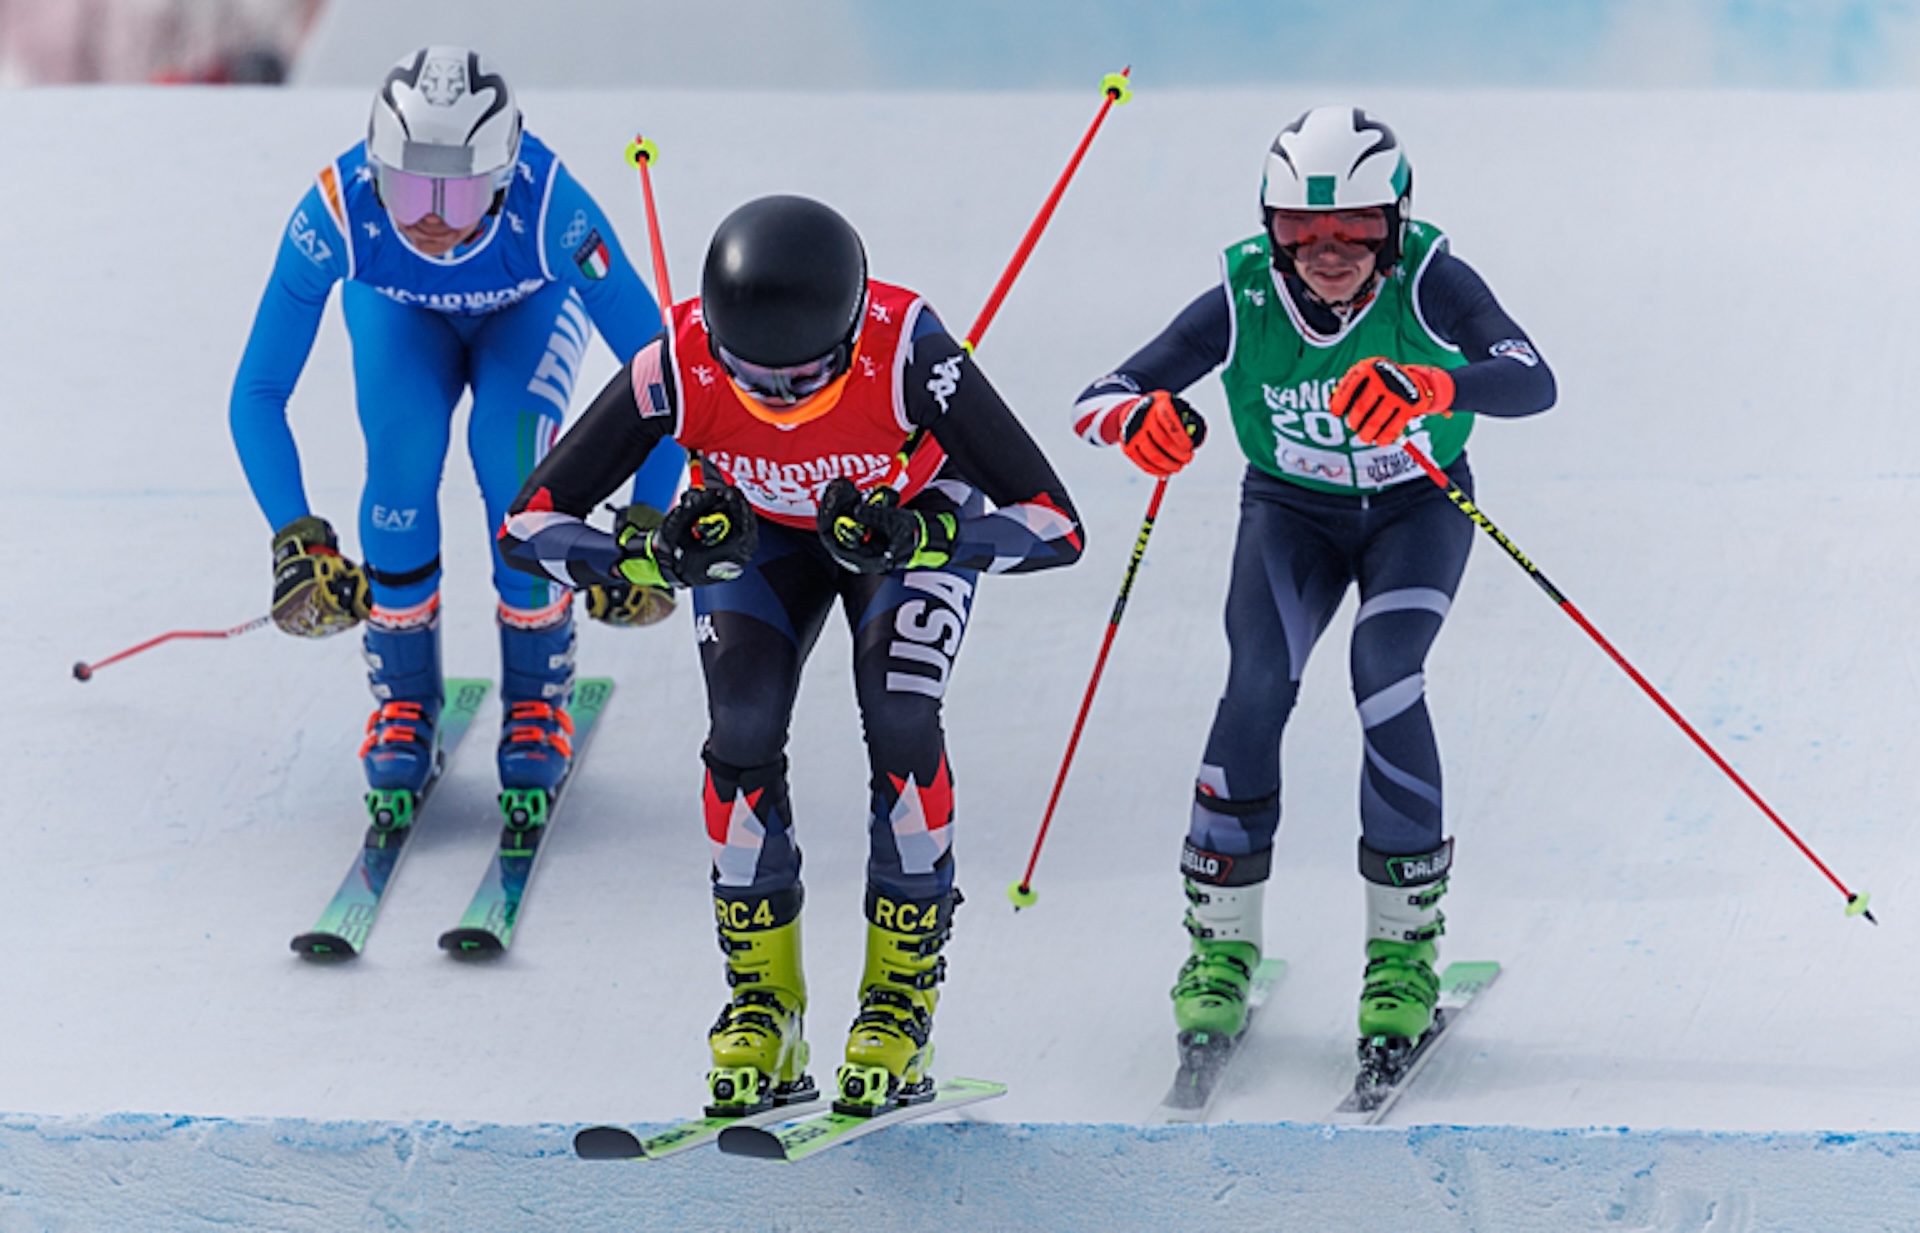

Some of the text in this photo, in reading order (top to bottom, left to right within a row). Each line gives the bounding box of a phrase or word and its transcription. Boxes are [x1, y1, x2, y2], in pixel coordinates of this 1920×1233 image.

[289, 209, 332, 261] EA7
[371, 504, 418, 528] EA7
[886, 571, 972, 700] USA
[716, 898, 774, 930] RC4
[875, 896, 938, 933] RC4
